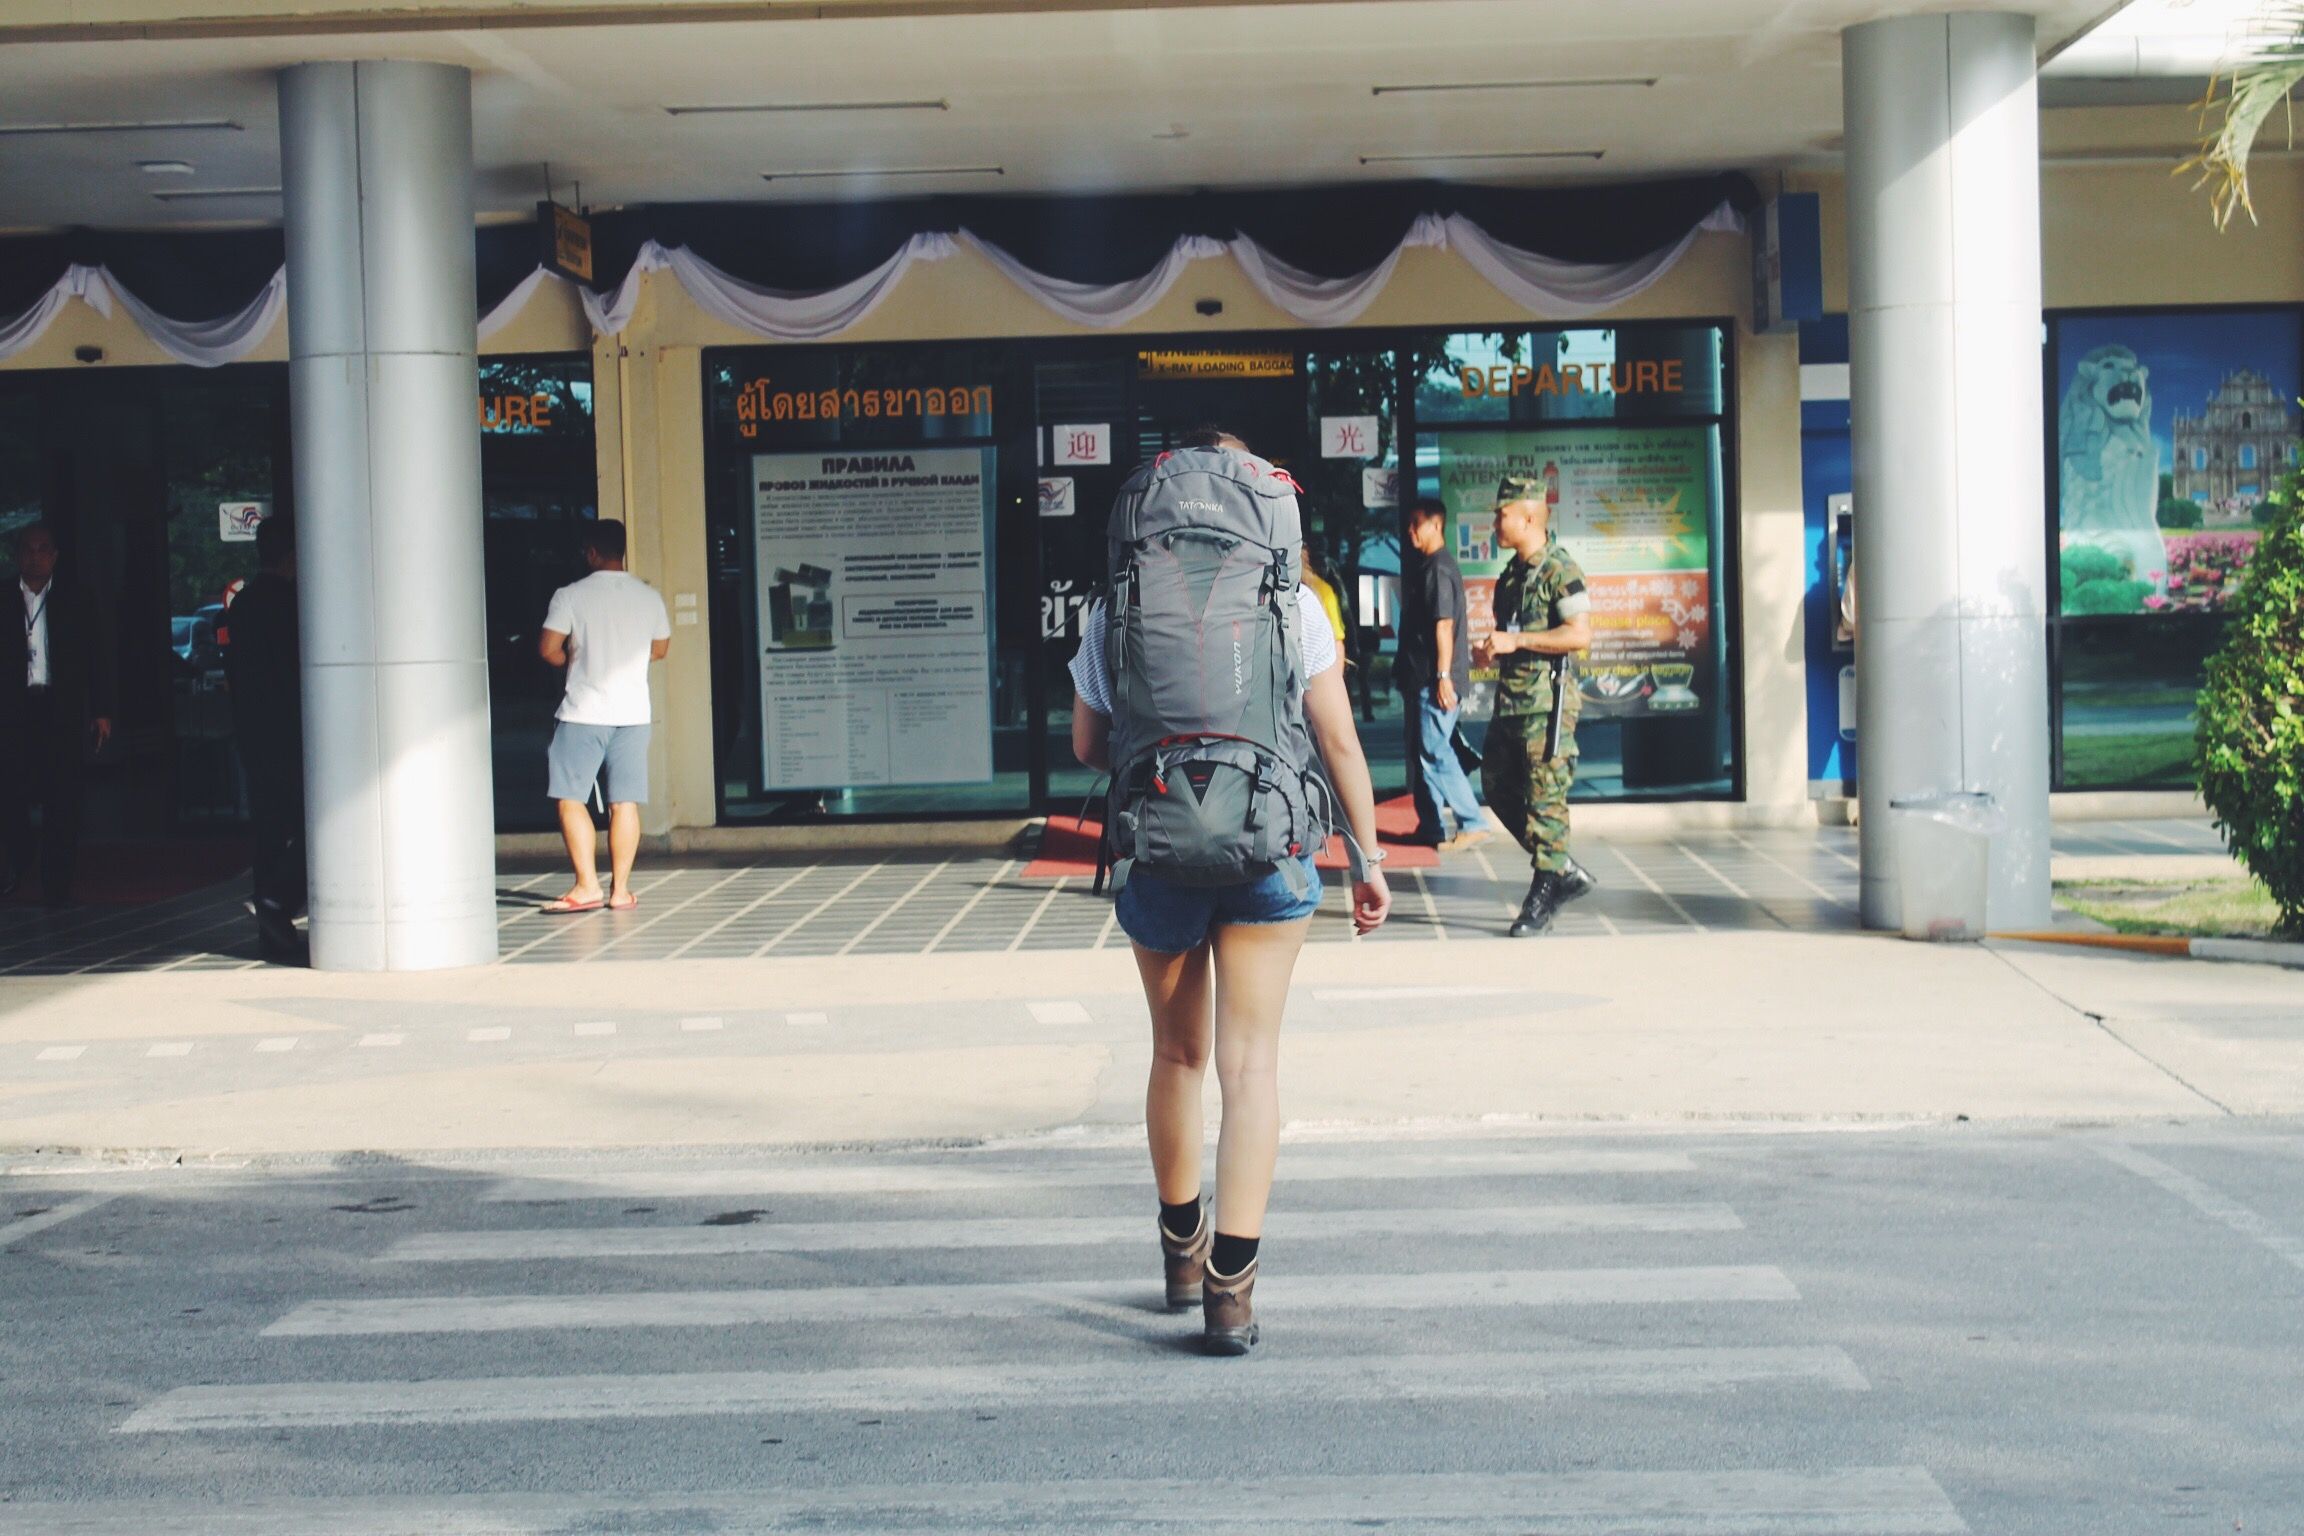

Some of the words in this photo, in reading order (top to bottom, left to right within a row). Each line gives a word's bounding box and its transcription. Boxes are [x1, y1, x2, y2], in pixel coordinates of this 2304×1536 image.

[1197, 361, 1245, 373] LOADING
[1461, 359, 1684, 398] DEPARTURE
[736, 378, 993, 437] ผู้โดยสารขาออก
[1067, 431, 1097, 460] 迎
[1335, 423, 1365, 454] 光
[821, 455, 916, 475] ПРАВИЛА
[891, 474, 939, 488] РУЧНОЙ
[1178, 499, 1224, 513] TATONKA
